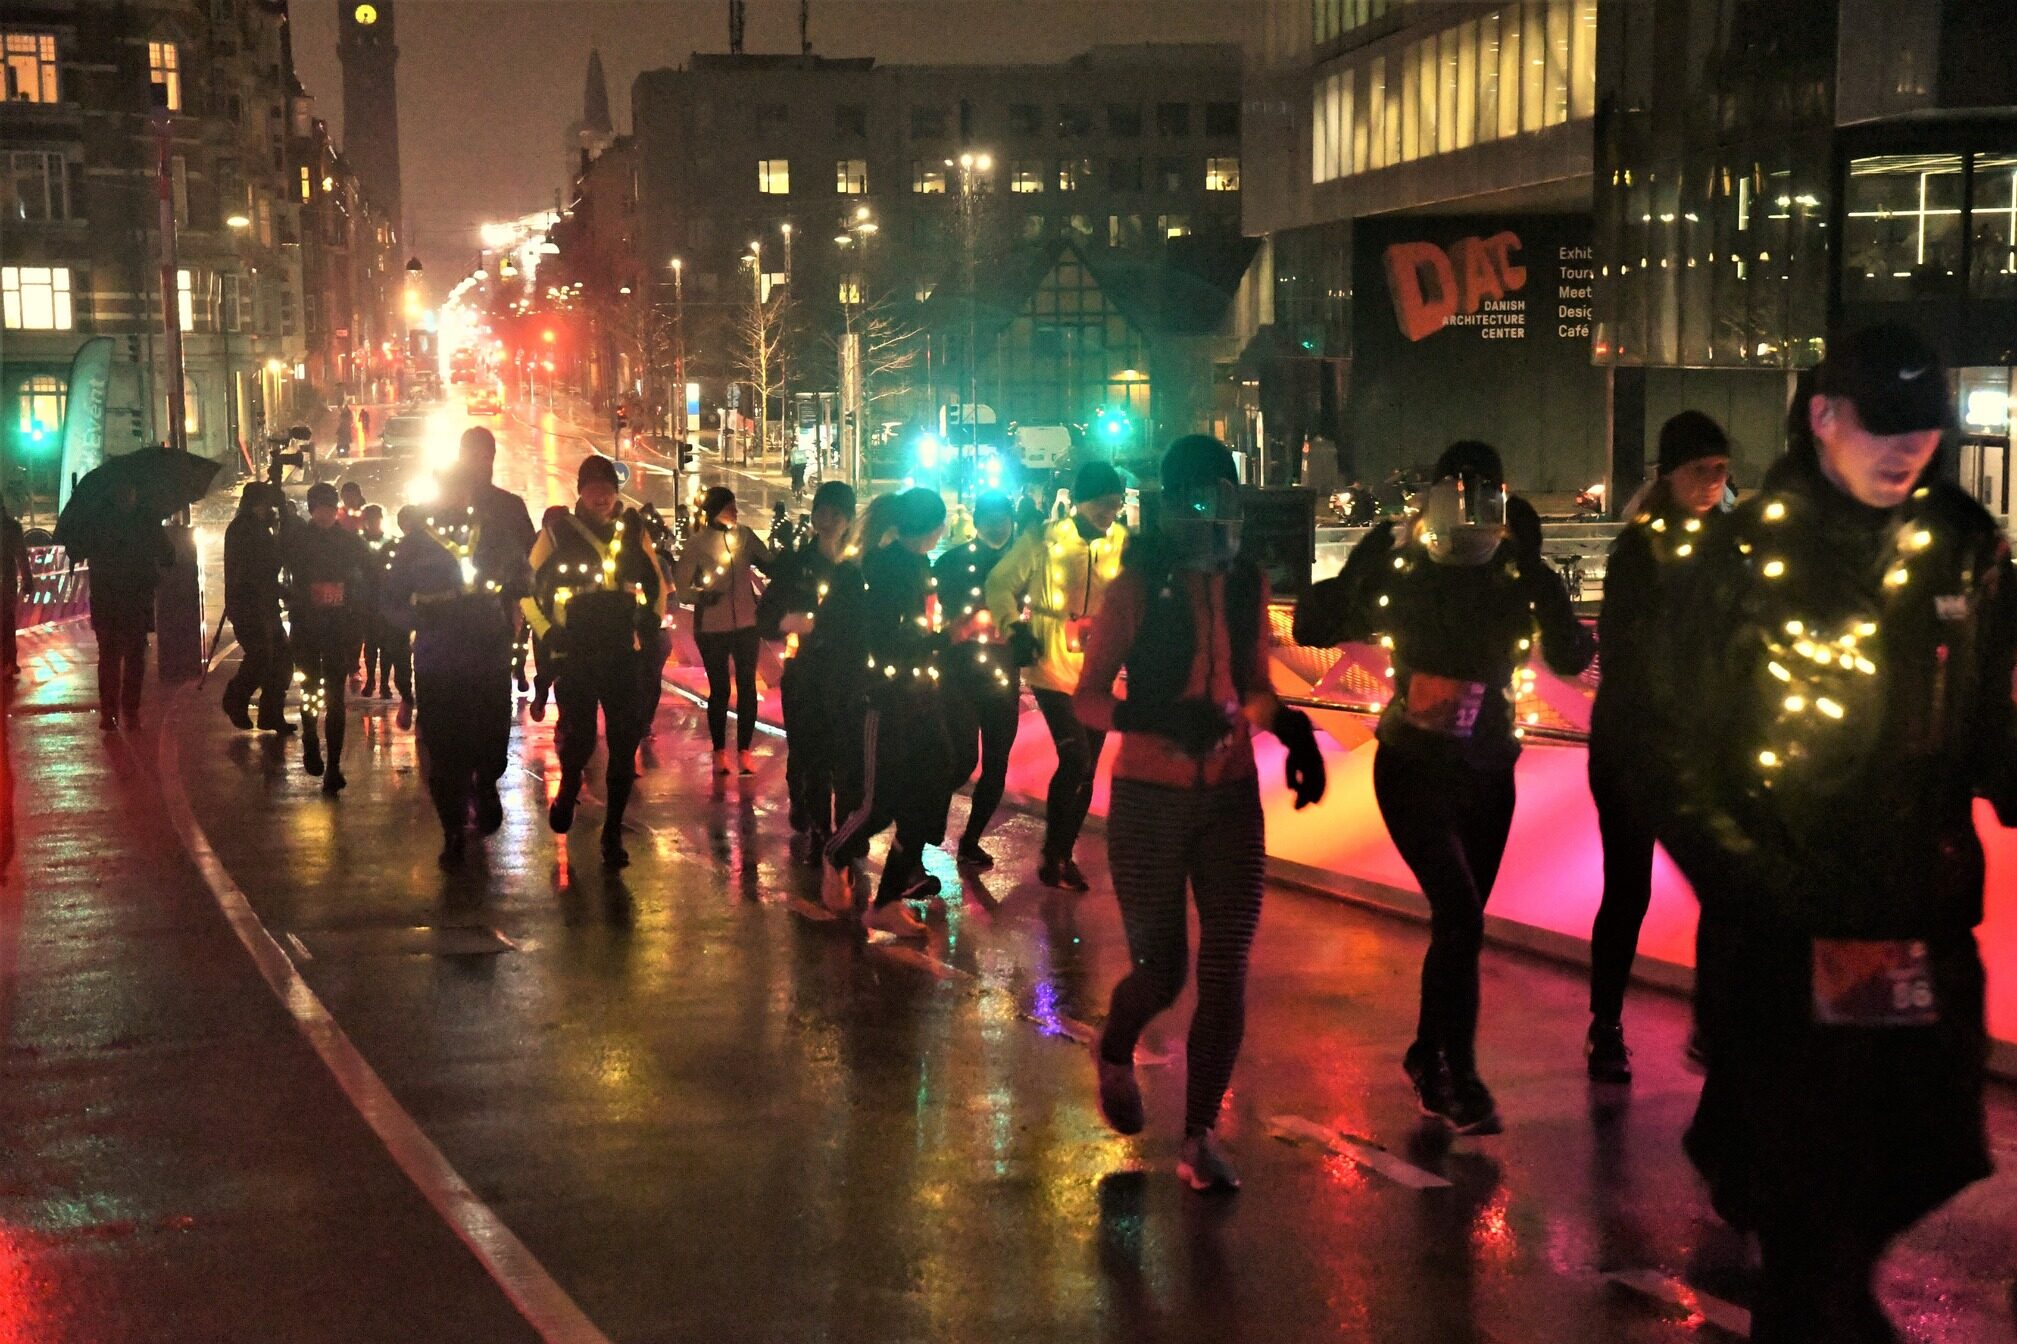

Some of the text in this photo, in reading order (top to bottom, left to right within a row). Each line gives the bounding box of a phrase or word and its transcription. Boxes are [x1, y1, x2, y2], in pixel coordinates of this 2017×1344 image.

[1382, 231, 1527, 342] DAC
[1559, 286, 1592, 299] Meet
[1484, 300, 1526, 312] DANISH
[1442, 314, 1526, 326] ARCHITECTURE
[1481, 327, 1525, 339] CENTER
[1558, 323, 1590, 338] Café
